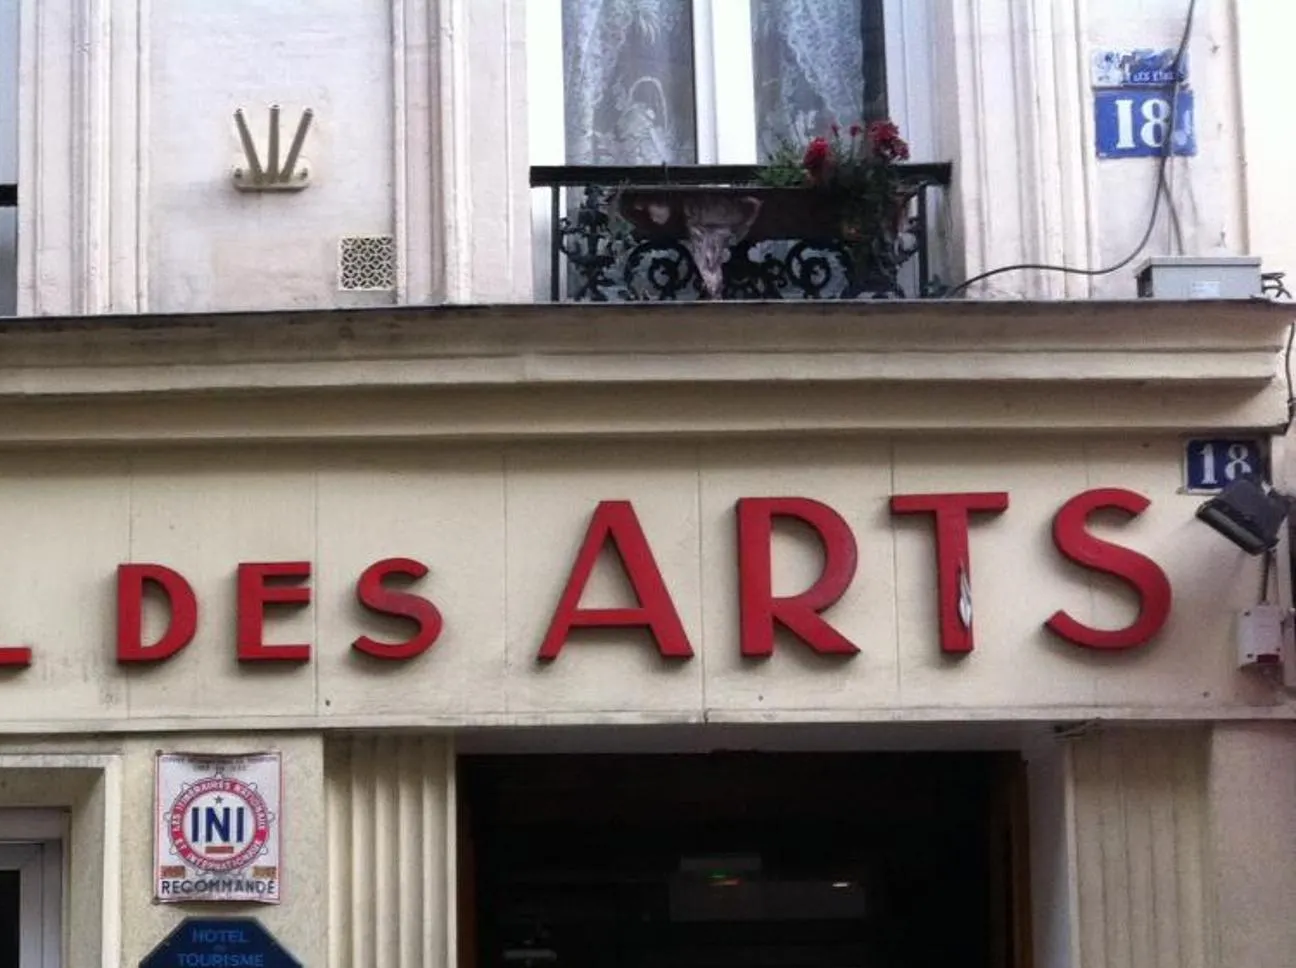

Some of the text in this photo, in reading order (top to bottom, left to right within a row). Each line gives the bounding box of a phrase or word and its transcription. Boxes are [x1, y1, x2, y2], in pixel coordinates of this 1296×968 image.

[1115, 98, 1171, 149] 18
[1199, 443, 1252, 485] 18
[117, 557, 442, 669] DES
[540, 487, 1173, 666] ARTS
[191, 806, 245, 843] INI
[177, 953, 264, 968] TOURISME
